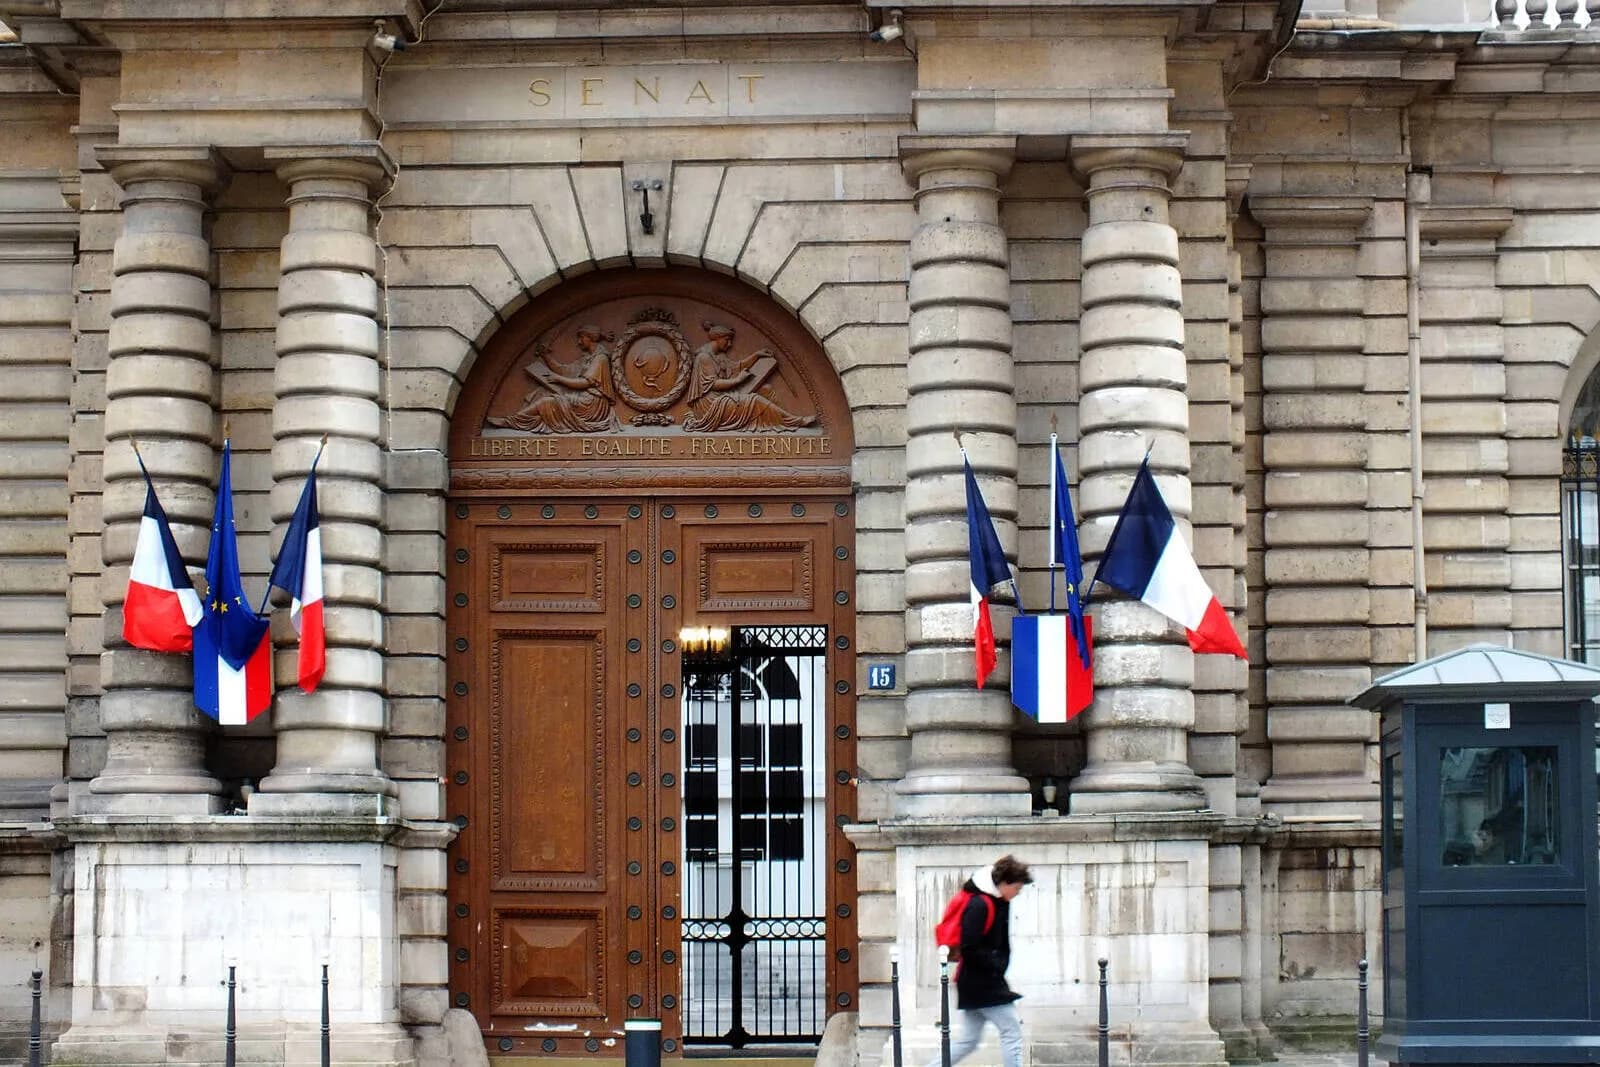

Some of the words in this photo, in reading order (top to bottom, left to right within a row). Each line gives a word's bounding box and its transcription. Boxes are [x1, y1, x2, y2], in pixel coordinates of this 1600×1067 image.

[528, 75, 765, 106] SENAT
[470, 438, 560, 456] LIBERTE
[581, 437, 672, 456] EGALITE
[691, 436, 832, 455] FRATERNITE
[871, 667, 891, 687] 15
